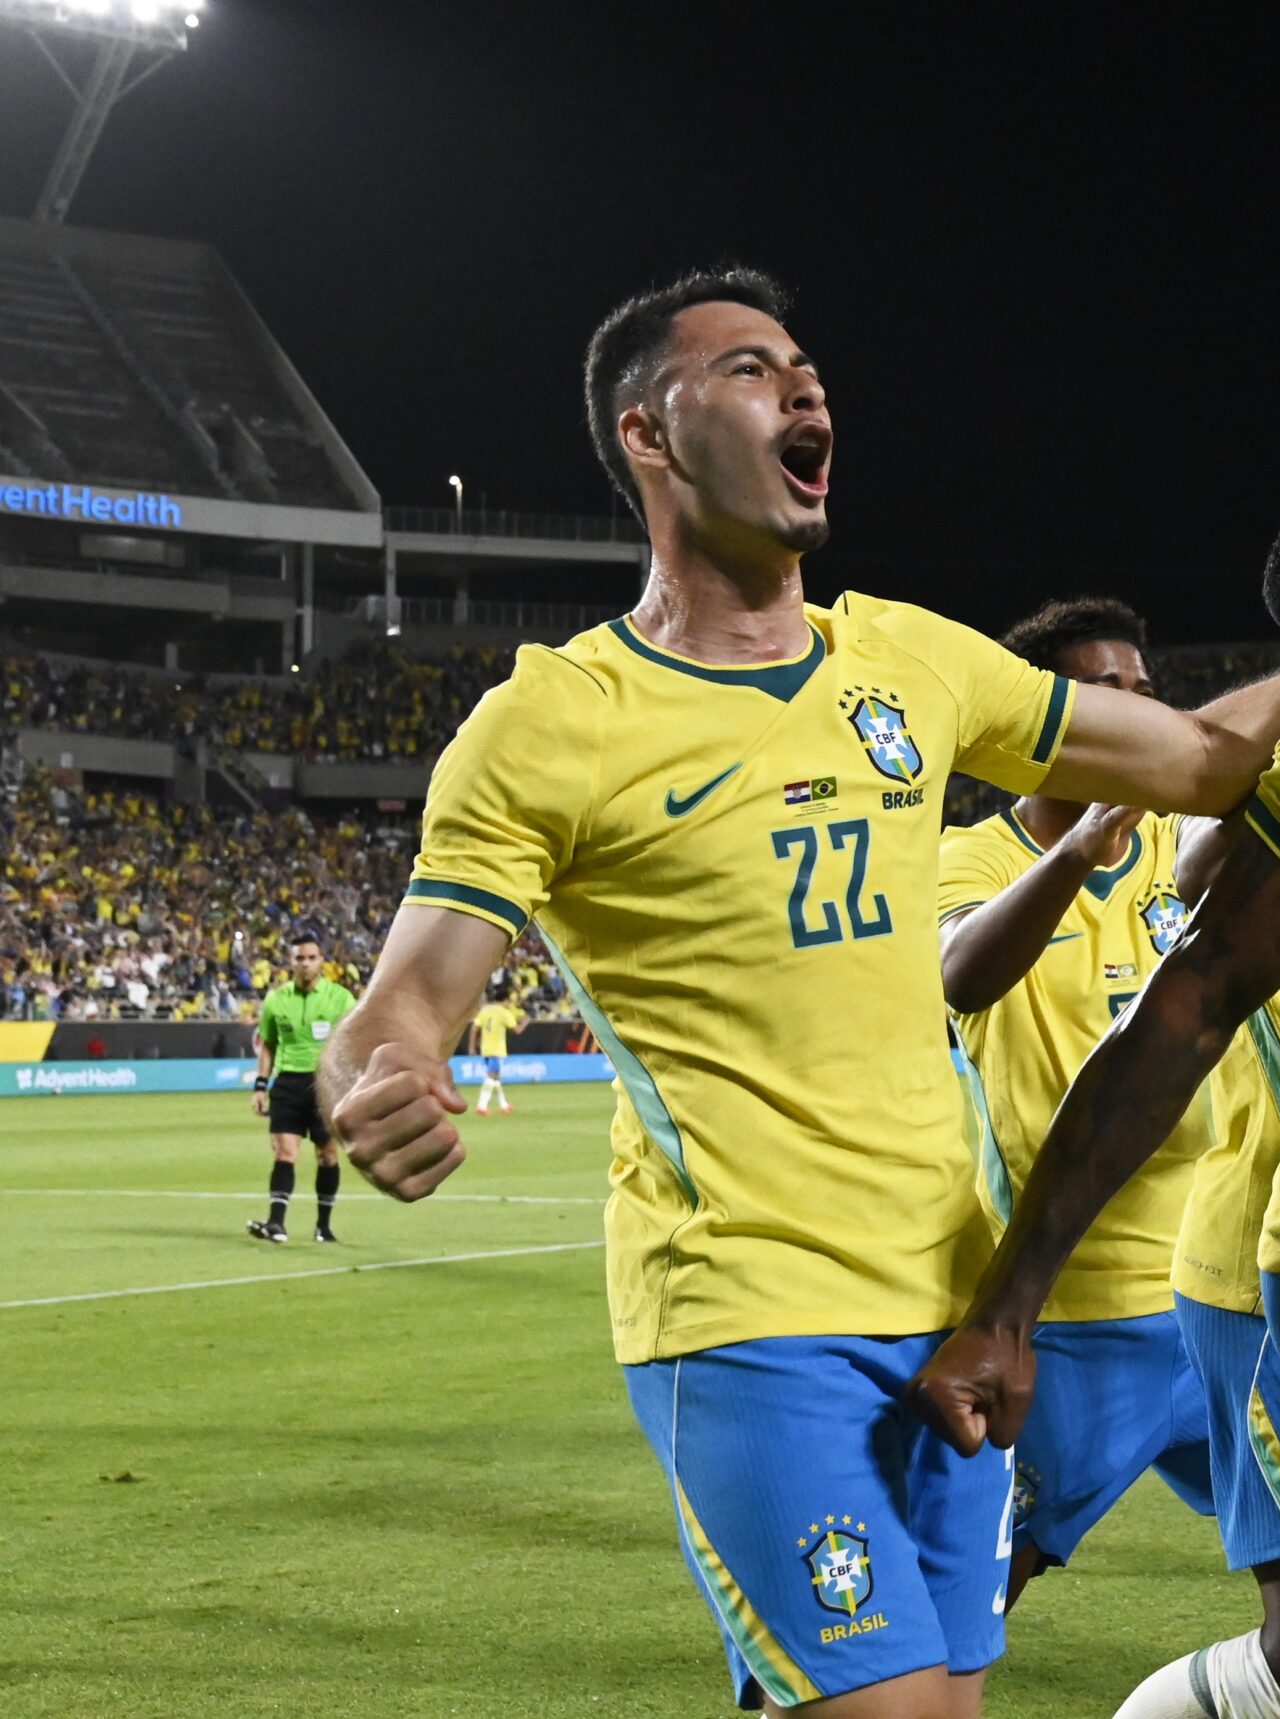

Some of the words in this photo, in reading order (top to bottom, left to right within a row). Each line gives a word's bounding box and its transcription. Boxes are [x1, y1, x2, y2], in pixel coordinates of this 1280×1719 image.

[875, 731, 896, 745] CBF
[881, 787, 924, 810] BRASIL
[771, 818, 893, 949] 22
[1160, 919, 1178, 931] CBF
[34, 1067, 137, 1089] AdventHealth
[829, 1563, 854, 1578] CBF
[820, 1612, 889, 1644] BRASIL
